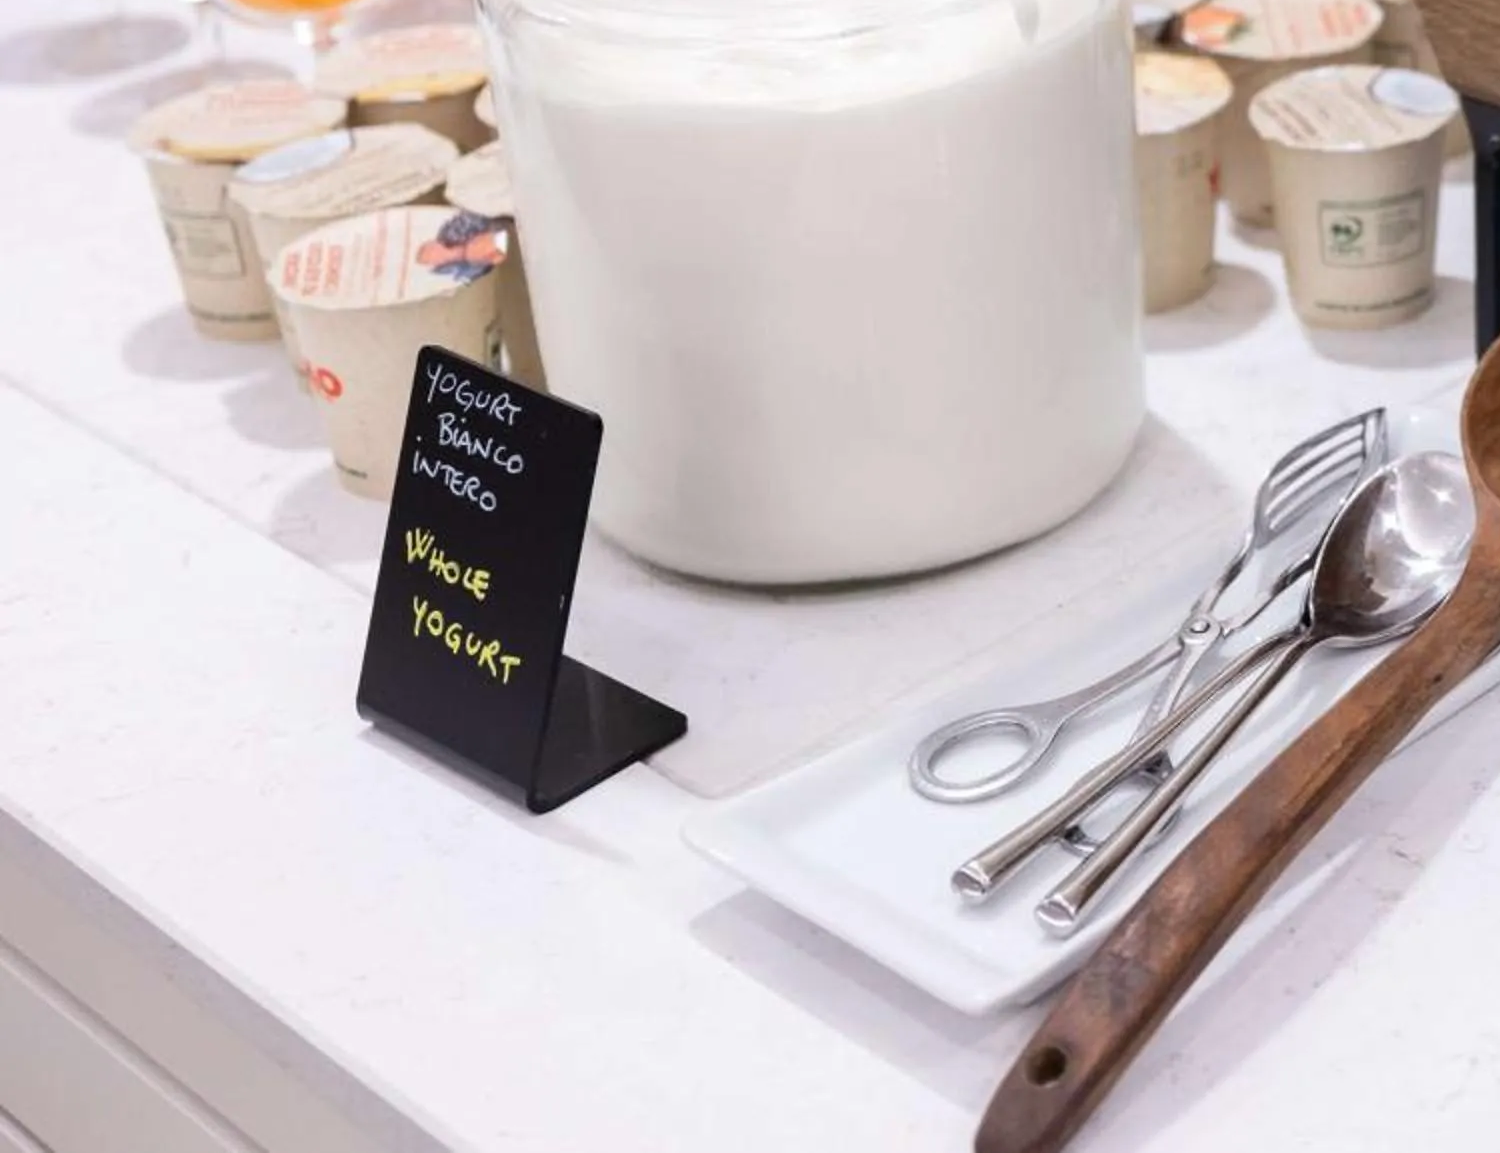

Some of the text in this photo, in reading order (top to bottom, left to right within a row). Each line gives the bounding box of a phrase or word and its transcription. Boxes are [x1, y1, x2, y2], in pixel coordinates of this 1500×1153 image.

[427, 363, 522, 425] YOGURT
[405, 527, 491, 600] WHOLE
[412, 595, 521, 685] YOGURT
